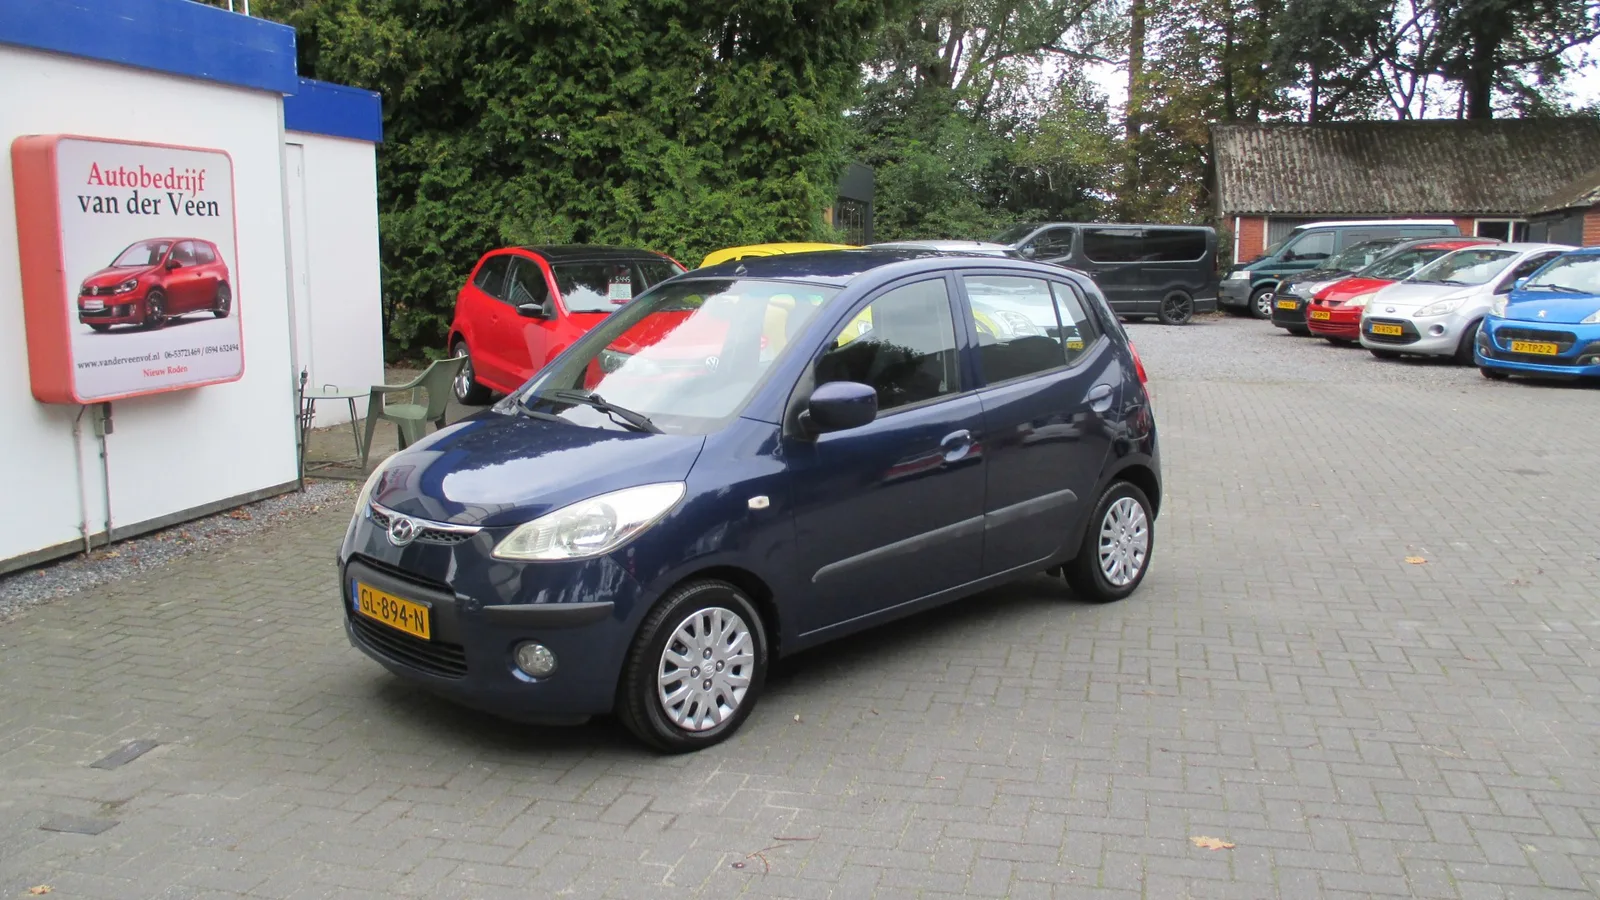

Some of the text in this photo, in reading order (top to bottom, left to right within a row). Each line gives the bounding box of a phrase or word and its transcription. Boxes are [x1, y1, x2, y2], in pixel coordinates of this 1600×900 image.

[87, 162, 205, 198] Autobedrijf
[77, 189, 220, 217] van der Veen
[1514, 342, 1553, 354] 27-TPZ-2
[77, 352, 160, 369] www.vanderveenvof.nl
[143, 365, 188, 377] Nieuw Roden
[361, 588, 425, 633] GL-894-N
